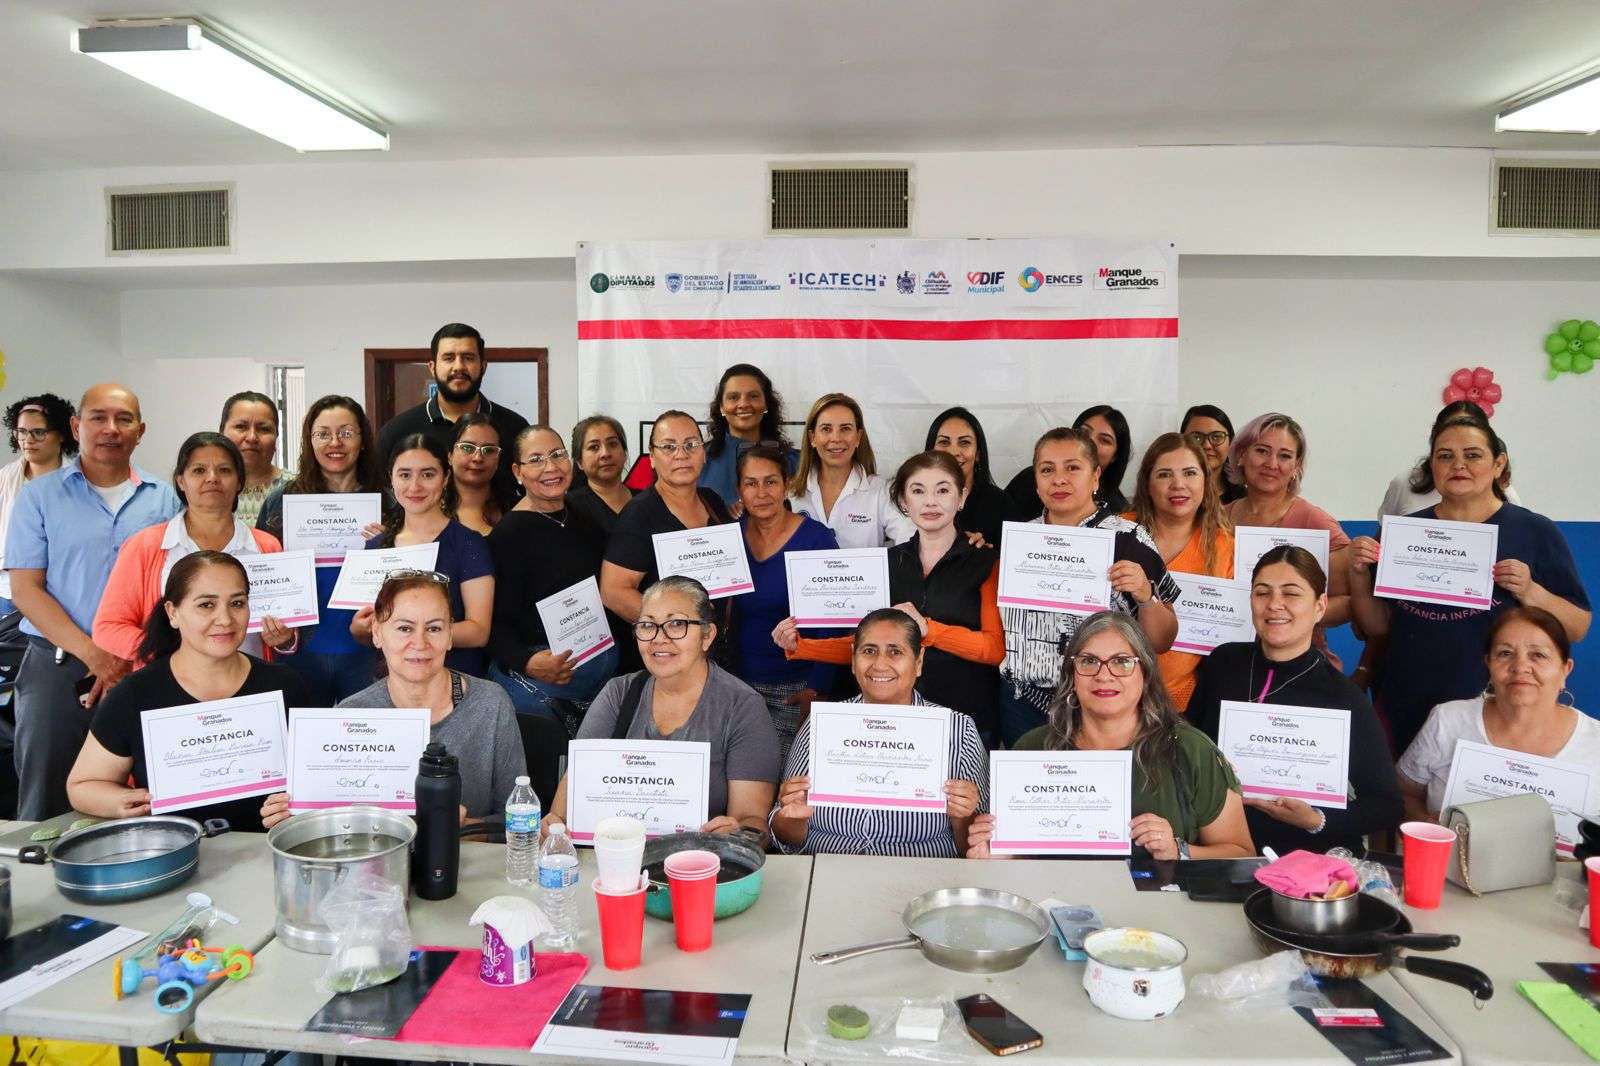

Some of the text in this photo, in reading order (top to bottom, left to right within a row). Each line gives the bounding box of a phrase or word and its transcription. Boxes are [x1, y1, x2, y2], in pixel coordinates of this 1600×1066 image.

[980, 271, 1005, 284] DIF
[1099, 267, 1142, 278] Manque
[799, 272, 876, 286] ICATECH
[1045, 275, 1083, 284] ENCES
[1105, 276, 1158, 287] Granados
[968, 285, 1005, 294] Municipal
[678, 549, 724, 561] CONSTANCIA
[1407, 545, 1467, 557] CONSTANCIA
[1027, 552, 1086, 564] CONSTANCIA
[249, 577, 290, 587] NSTANCIA
[811, 575, 864, 583] CONSTANCIA
[1181, 600, 1235, 613] CONSTANCIA
[559, 606, 590, 626] CONSTANCIA
[180, 729, 254, 747] CONSTANCIA
[1249, 734, 1317, 747] CONSTANCIA
[323, 744, 396, 752] CONSTANCIA
[843, 739, 915, 750] CONSTANCIA
[602, 775, 675, 786] CONSTANCIA
[1483, 774, 1556, 797] CONSTANCIA
[1024, 785, 1097, 793] CONSTANCIA
